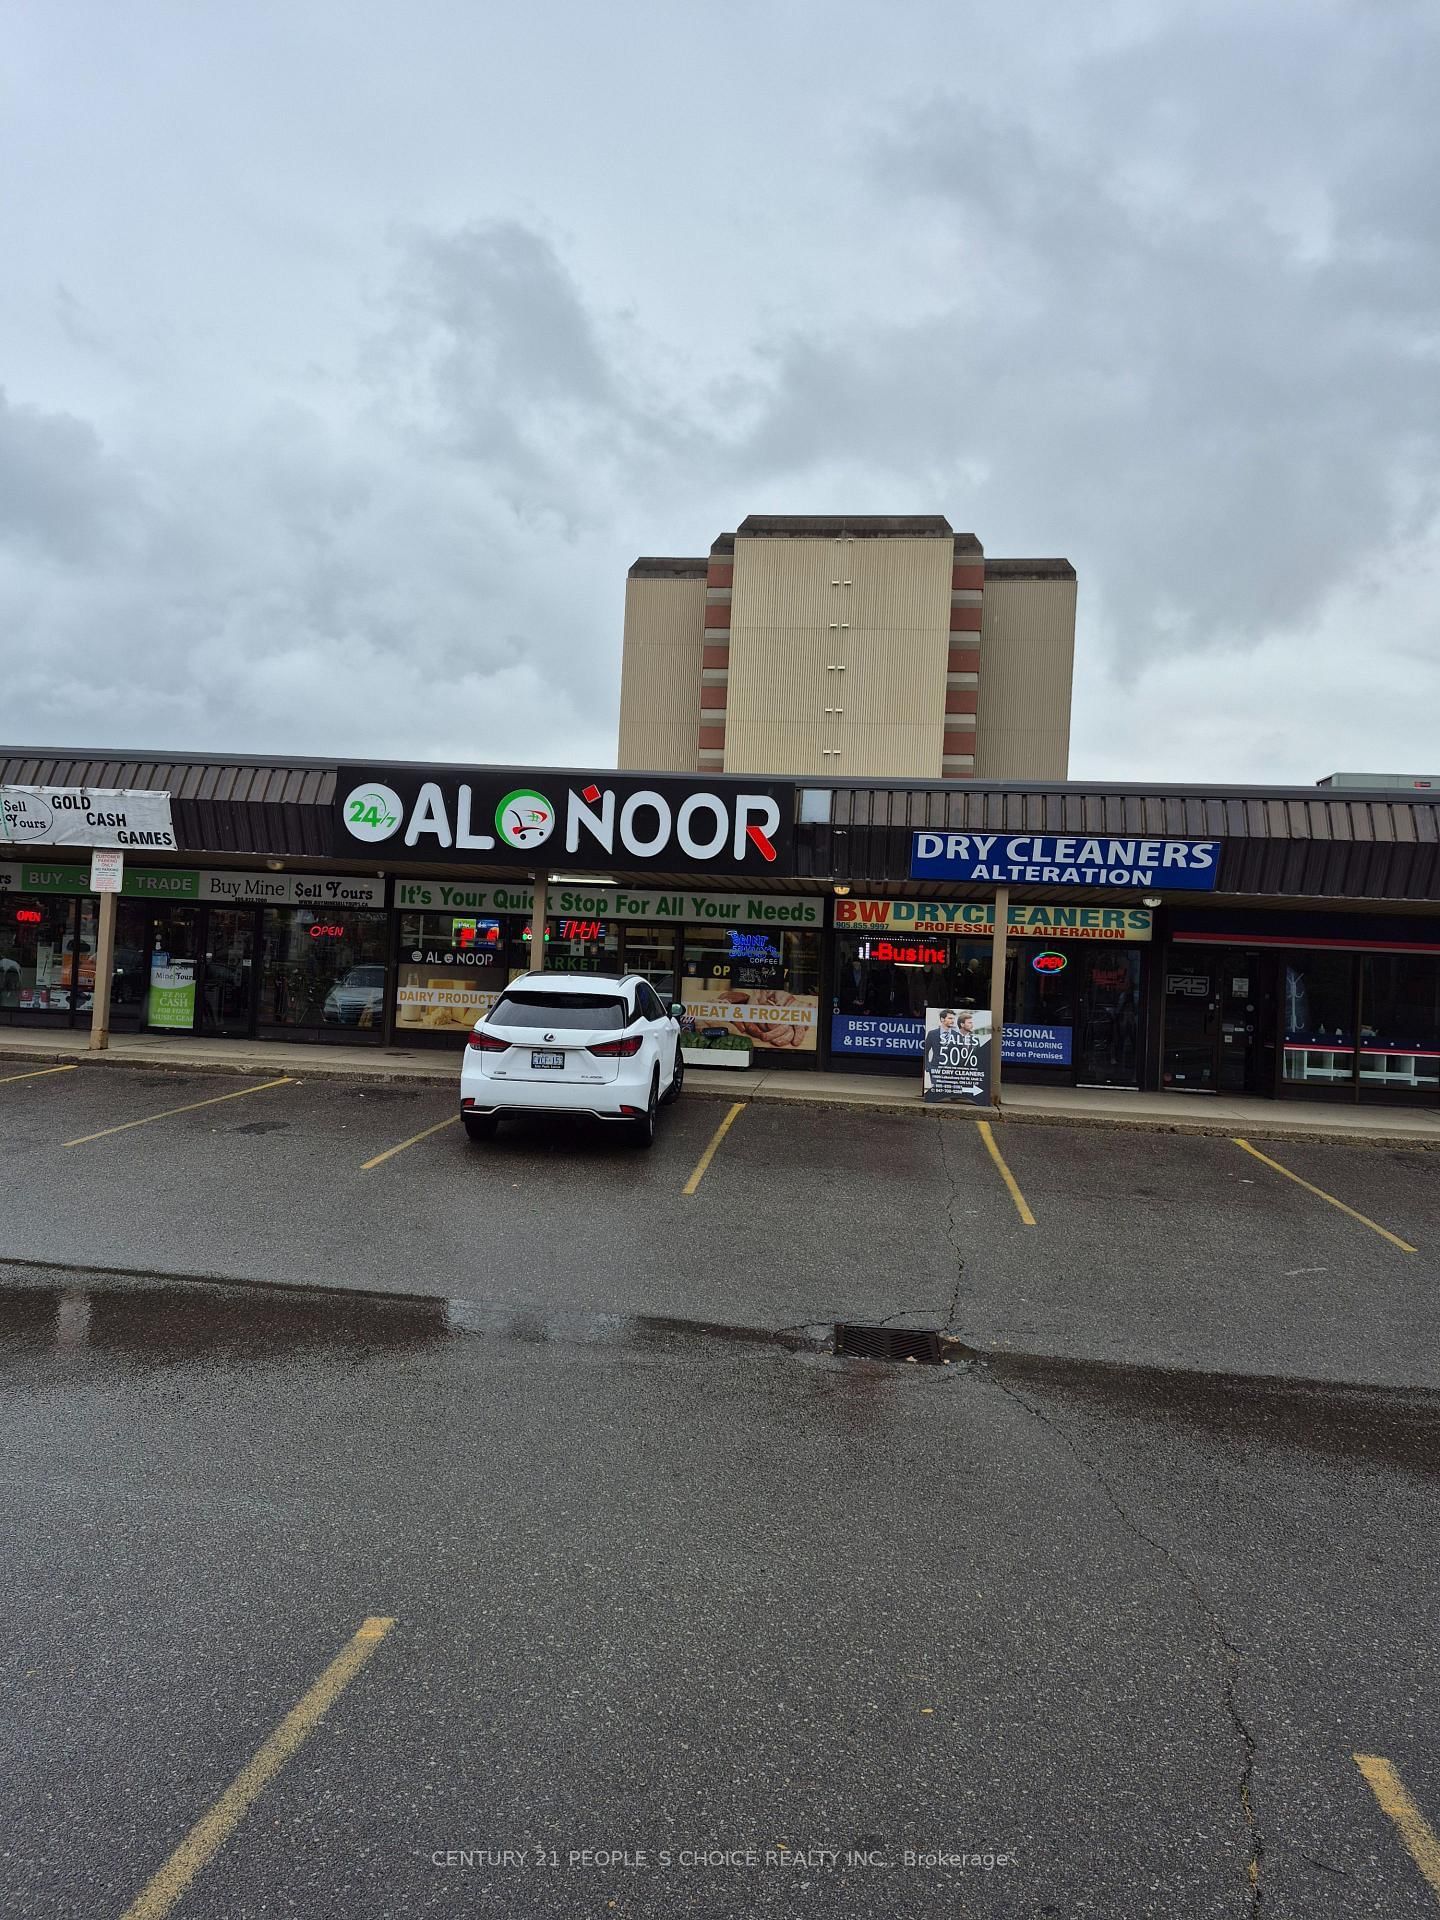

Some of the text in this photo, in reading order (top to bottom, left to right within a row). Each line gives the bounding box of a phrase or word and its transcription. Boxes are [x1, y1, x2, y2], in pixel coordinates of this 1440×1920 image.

[51, 795, 91, 810] GOLD
[5, 815, 46, 829] Yours
[86, 812, 127, 827] CASH
[349, 782, 780, 861] 24/7 AL NOOR
[117, 831, 172, 846] GAMES
[917, 834, 1214, 869] DRY CLEANERS
[29, 872, 63, 885] BUY
[970, 864, 1154, 886] ALTERATION
[135, 876, 193, 891] TRADE
[210, 878, 285, 897] Buy Mine
[326, 882, 373, 900] Yours
[439, 887, 487, 908] Your
[559, 892, 608, 917] Stop
[616, 895, 650, 914] For
[655, 896, 684, 916] All
[691, 897, 741, 919] Your
[747, 900, 816, 922] Needs
[836, 900, 891, 922] BW
[17, 910, 41, 922] OPEN
[309, 925, 344, 937] OPEN
[914, 922, 1126, 939] PROFESSIOAL ALTERATION
[426, 951, 442, 963] AL
[530, 956, 600, 971] ARKET
[155, 972, 174, 980] Mine
[1168, 976, 1208, 995] F45
[159, 997, 188, 1007] CASH
[399, 990, 434, 1003] DAIRY
[687, 1004, 812, 1023] MEAT & FROZEN
[848, 1020, 877, 1032] BEST
[843, 1035, 926, 1050] & BEST SERVIC
[939, 1033, 979, 1046] SALES
[1023, 1041, 1063, 1050] TAILORING
[938, 1046, 978, 1067] 50%
[1028, 1051, 1063, 1060] Premises
